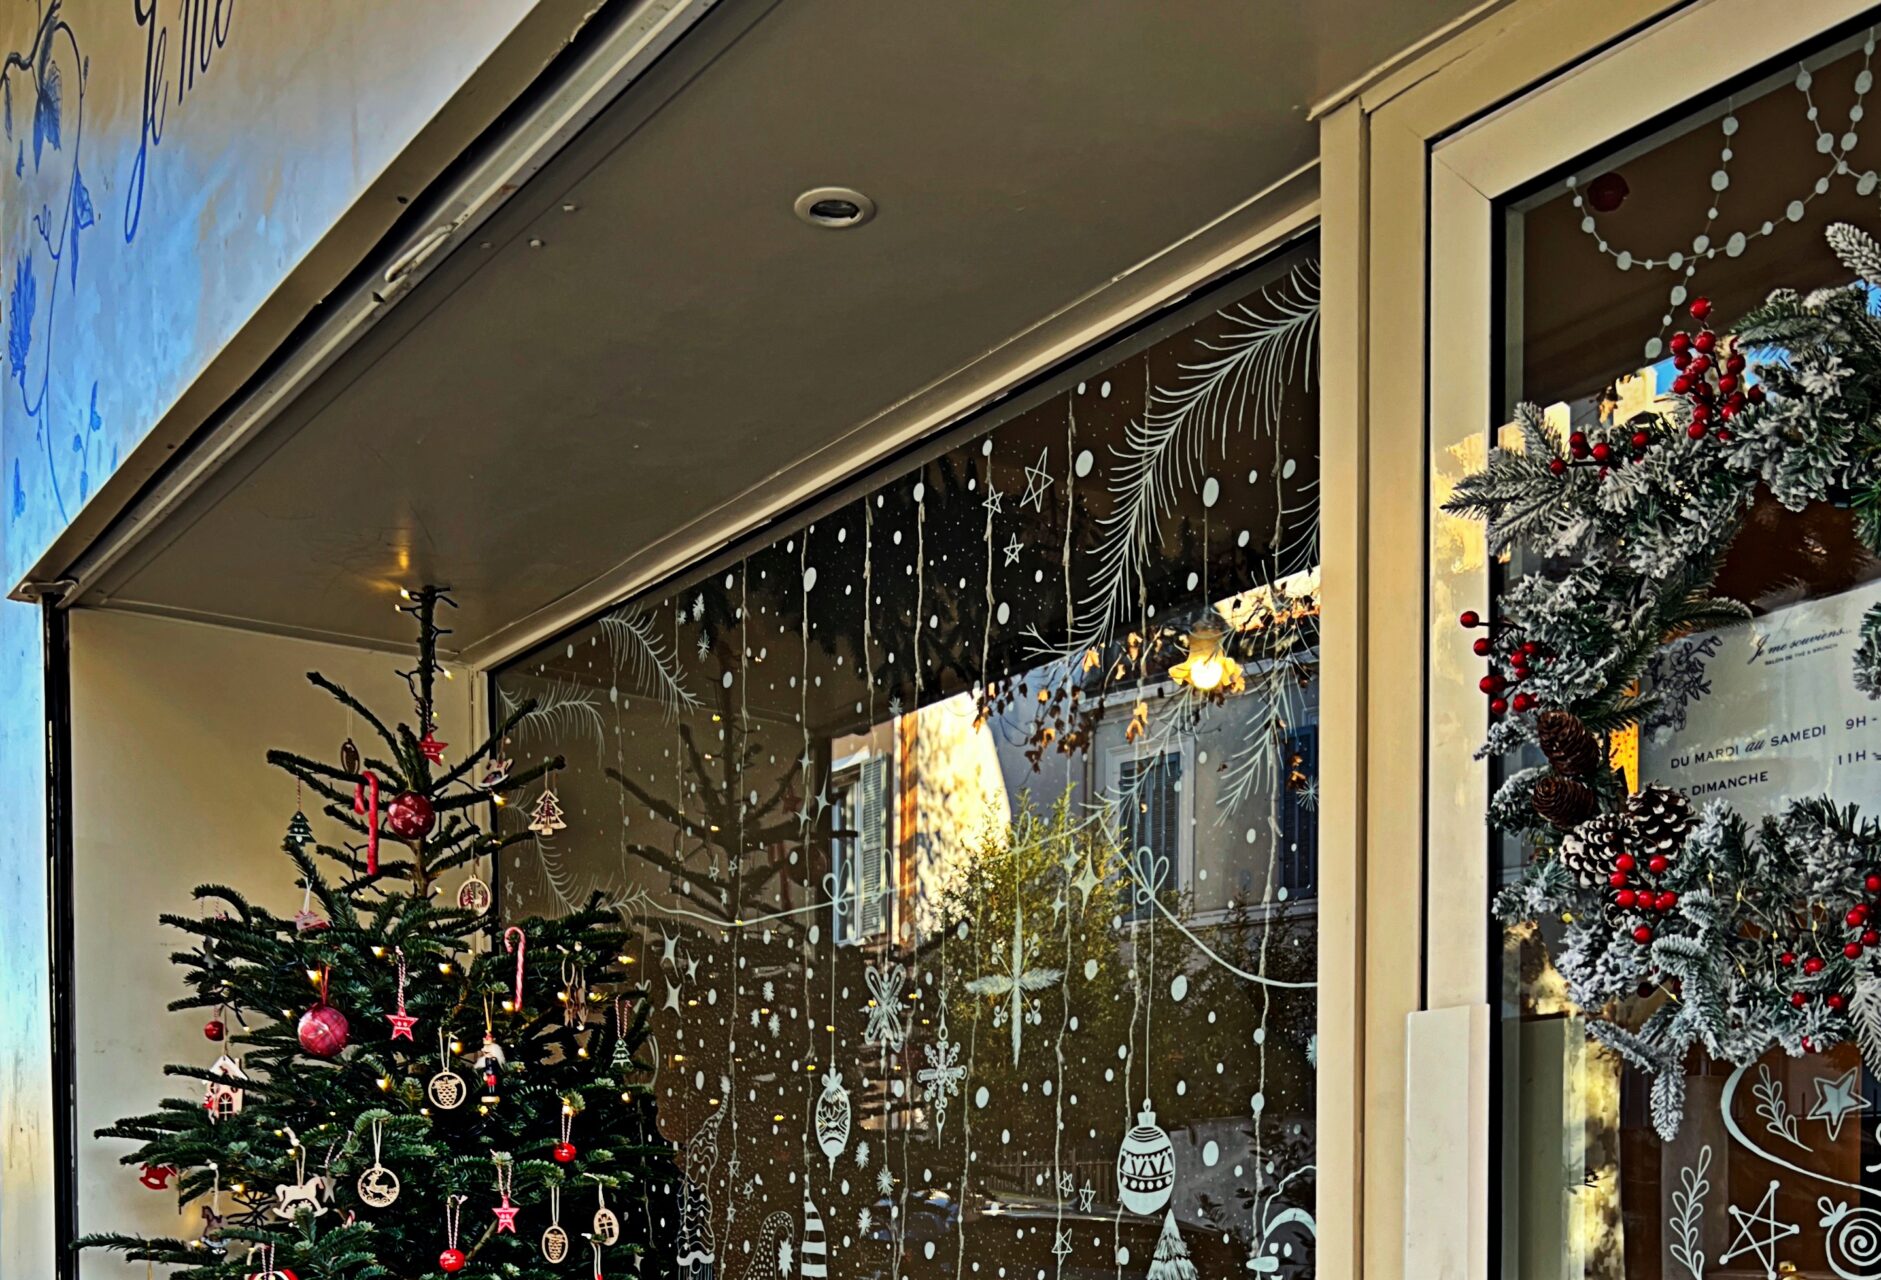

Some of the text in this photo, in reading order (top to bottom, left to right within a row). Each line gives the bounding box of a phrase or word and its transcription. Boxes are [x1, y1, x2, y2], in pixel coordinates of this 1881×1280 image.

[1747, 633, 1771, 665] Je
[1670, 756, 1690, 769] DU
[1694, 745, 1739, 764] MARDI
[1745, 739, 1766, 753] au
[1770, 725, 1827, 747] SAMEDI
[1845, 716, 1867, 730] 9H
[1691, 771, 1769, 797] DIMANCHE
[1838, 750, 1867, 765] 11H
